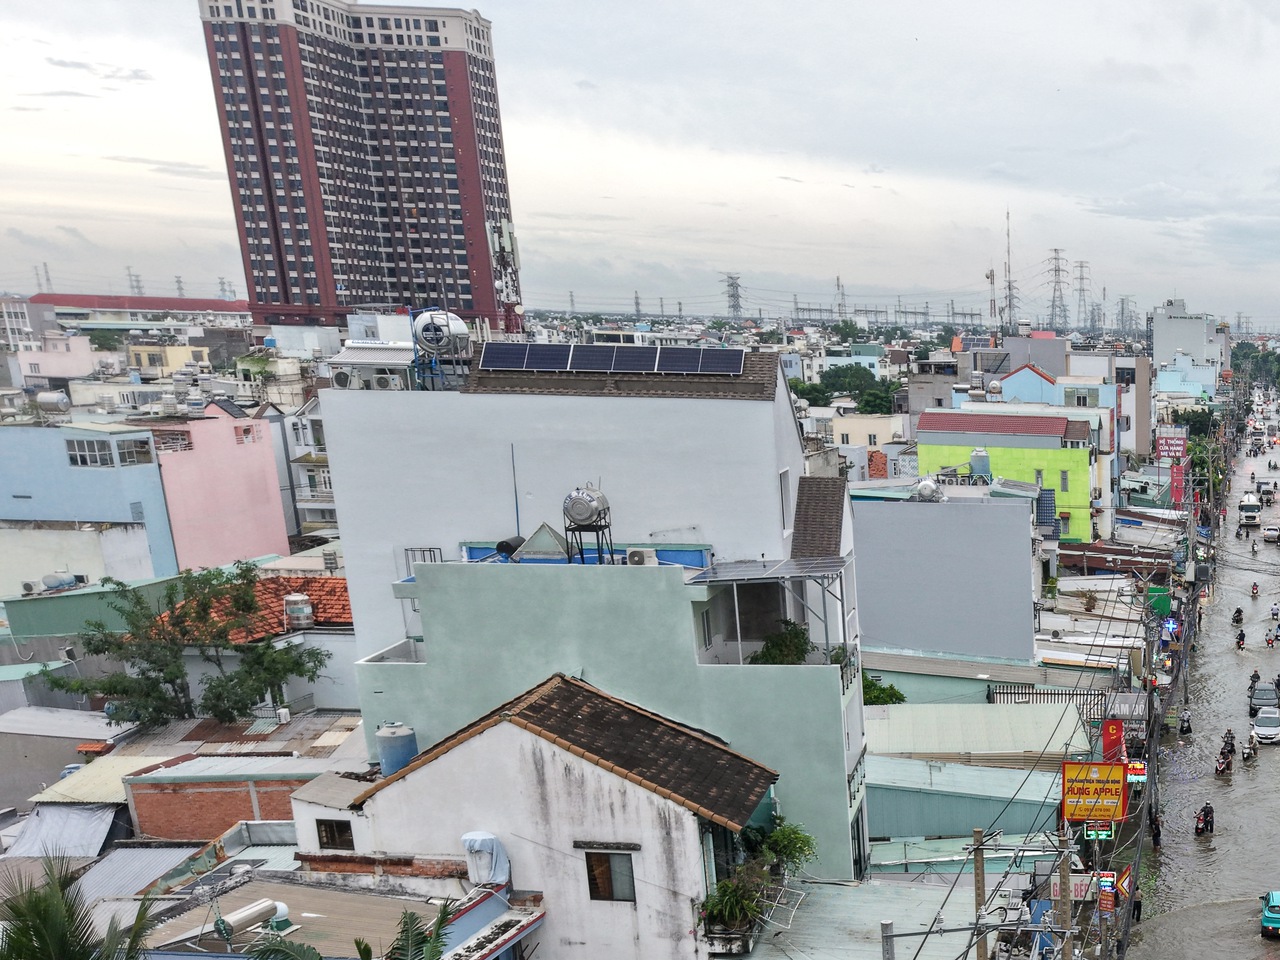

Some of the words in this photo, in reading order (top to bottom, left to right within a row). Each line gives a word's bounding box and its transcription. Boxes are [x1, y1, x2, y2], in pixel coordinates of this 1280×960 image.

[1167, 436, 1184, 445] THỐNG
[1067, 785, 1091, 796] HÙNG
[1092, 787, 1121, 797] APPLE
